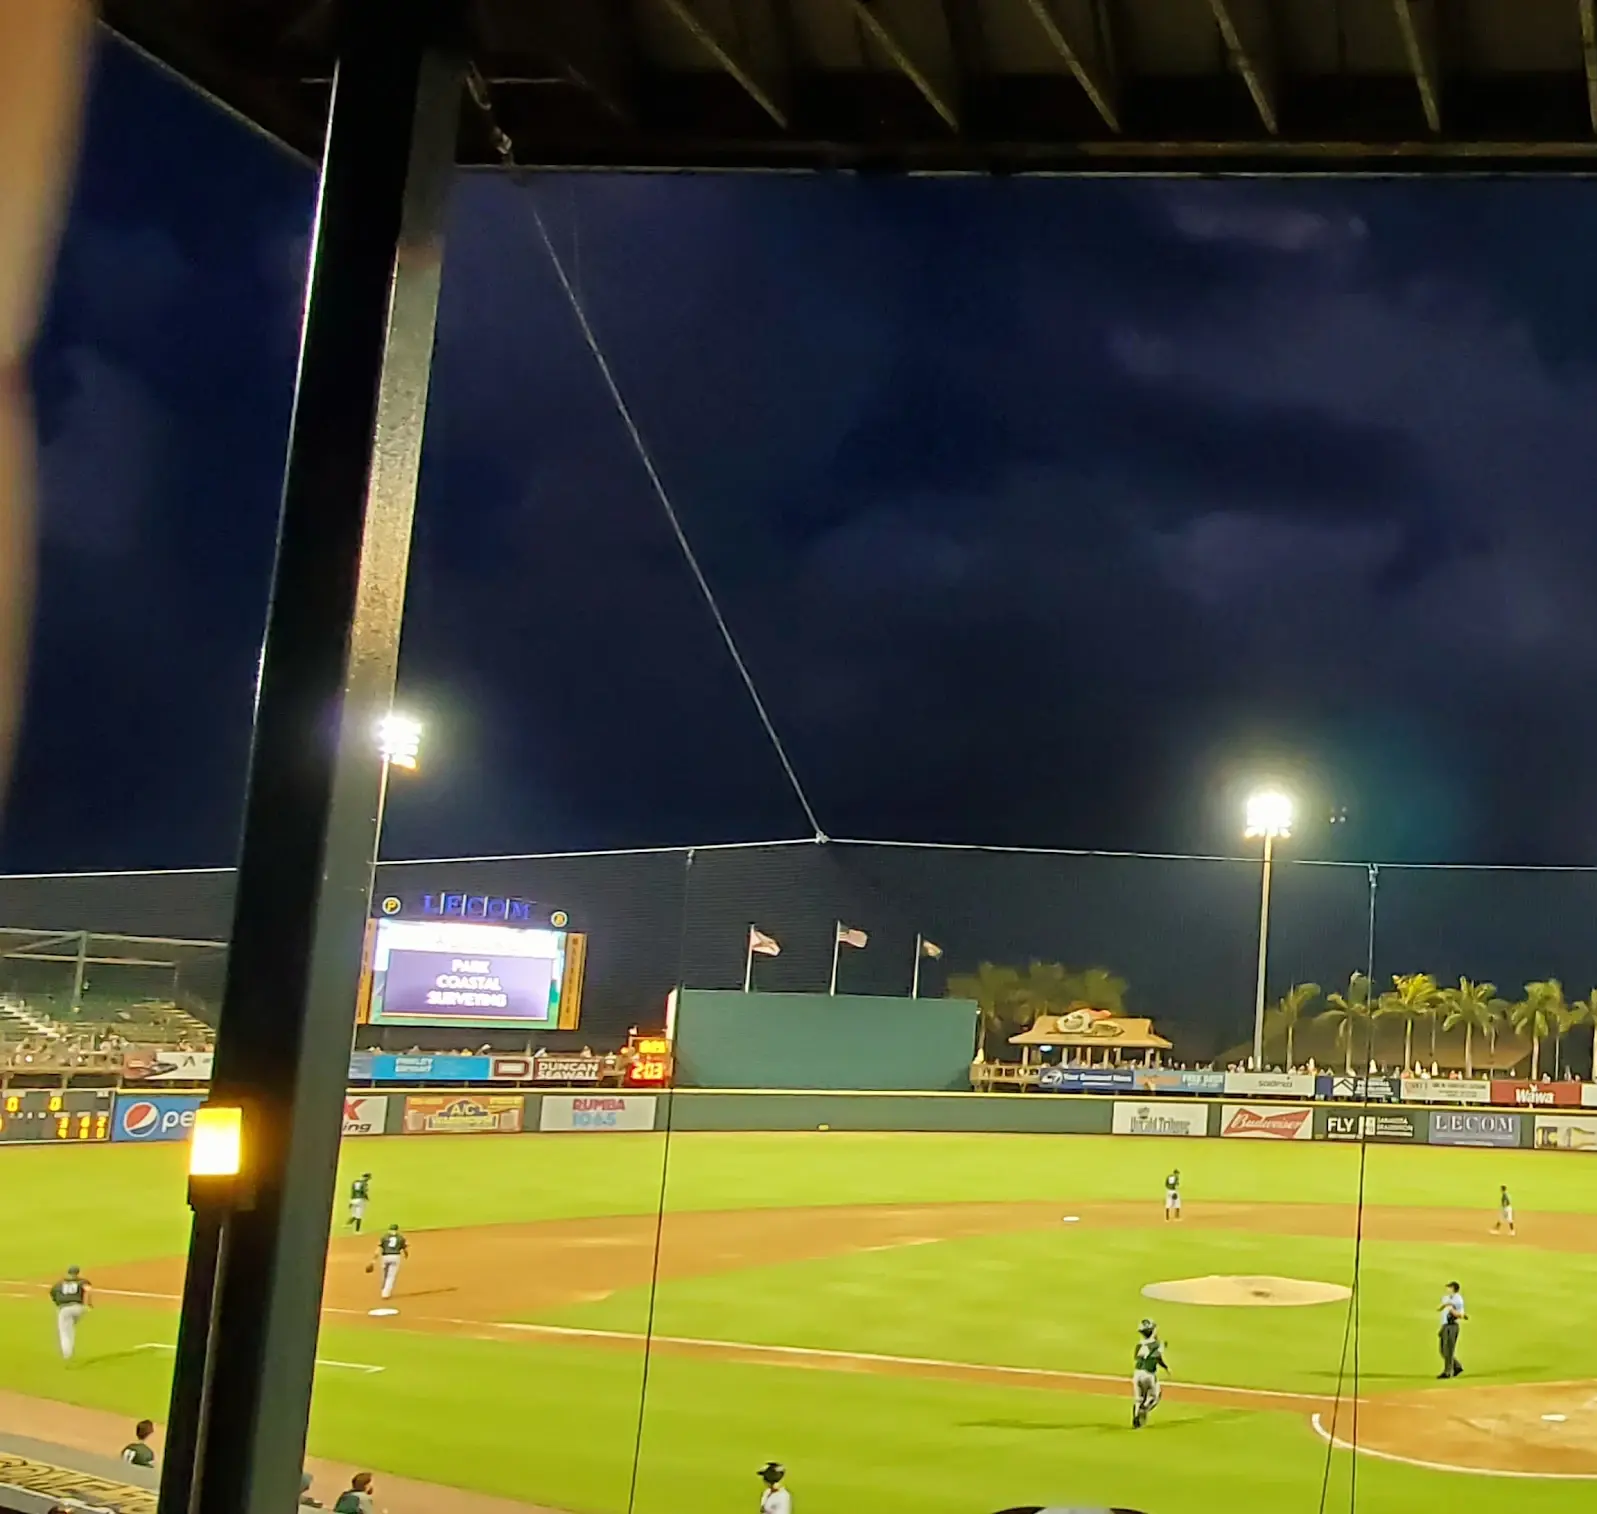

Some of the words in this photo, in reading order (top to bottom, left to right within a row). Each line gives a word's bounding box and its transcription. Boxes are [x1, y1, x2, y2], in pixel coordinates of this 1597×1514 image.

[424, 894, 530, 920] LECOM
[451, 958, 491, 974] PARK
[435, 974, 502, 991] COASTAL
[538, 1060, 599, 1072] DUNCAN
[537, 1069, 599, 1081] SEAWALL
[573, 1098, 626, 1111] RUMBA
[1515, 1088, 1555, 1105] Wawa
[1231, 1110, 1303, 1130] Budweiser
[1327, 1116, 1355, 1133] FLY
[1435, 1114, 1514, 1133] LECOM
